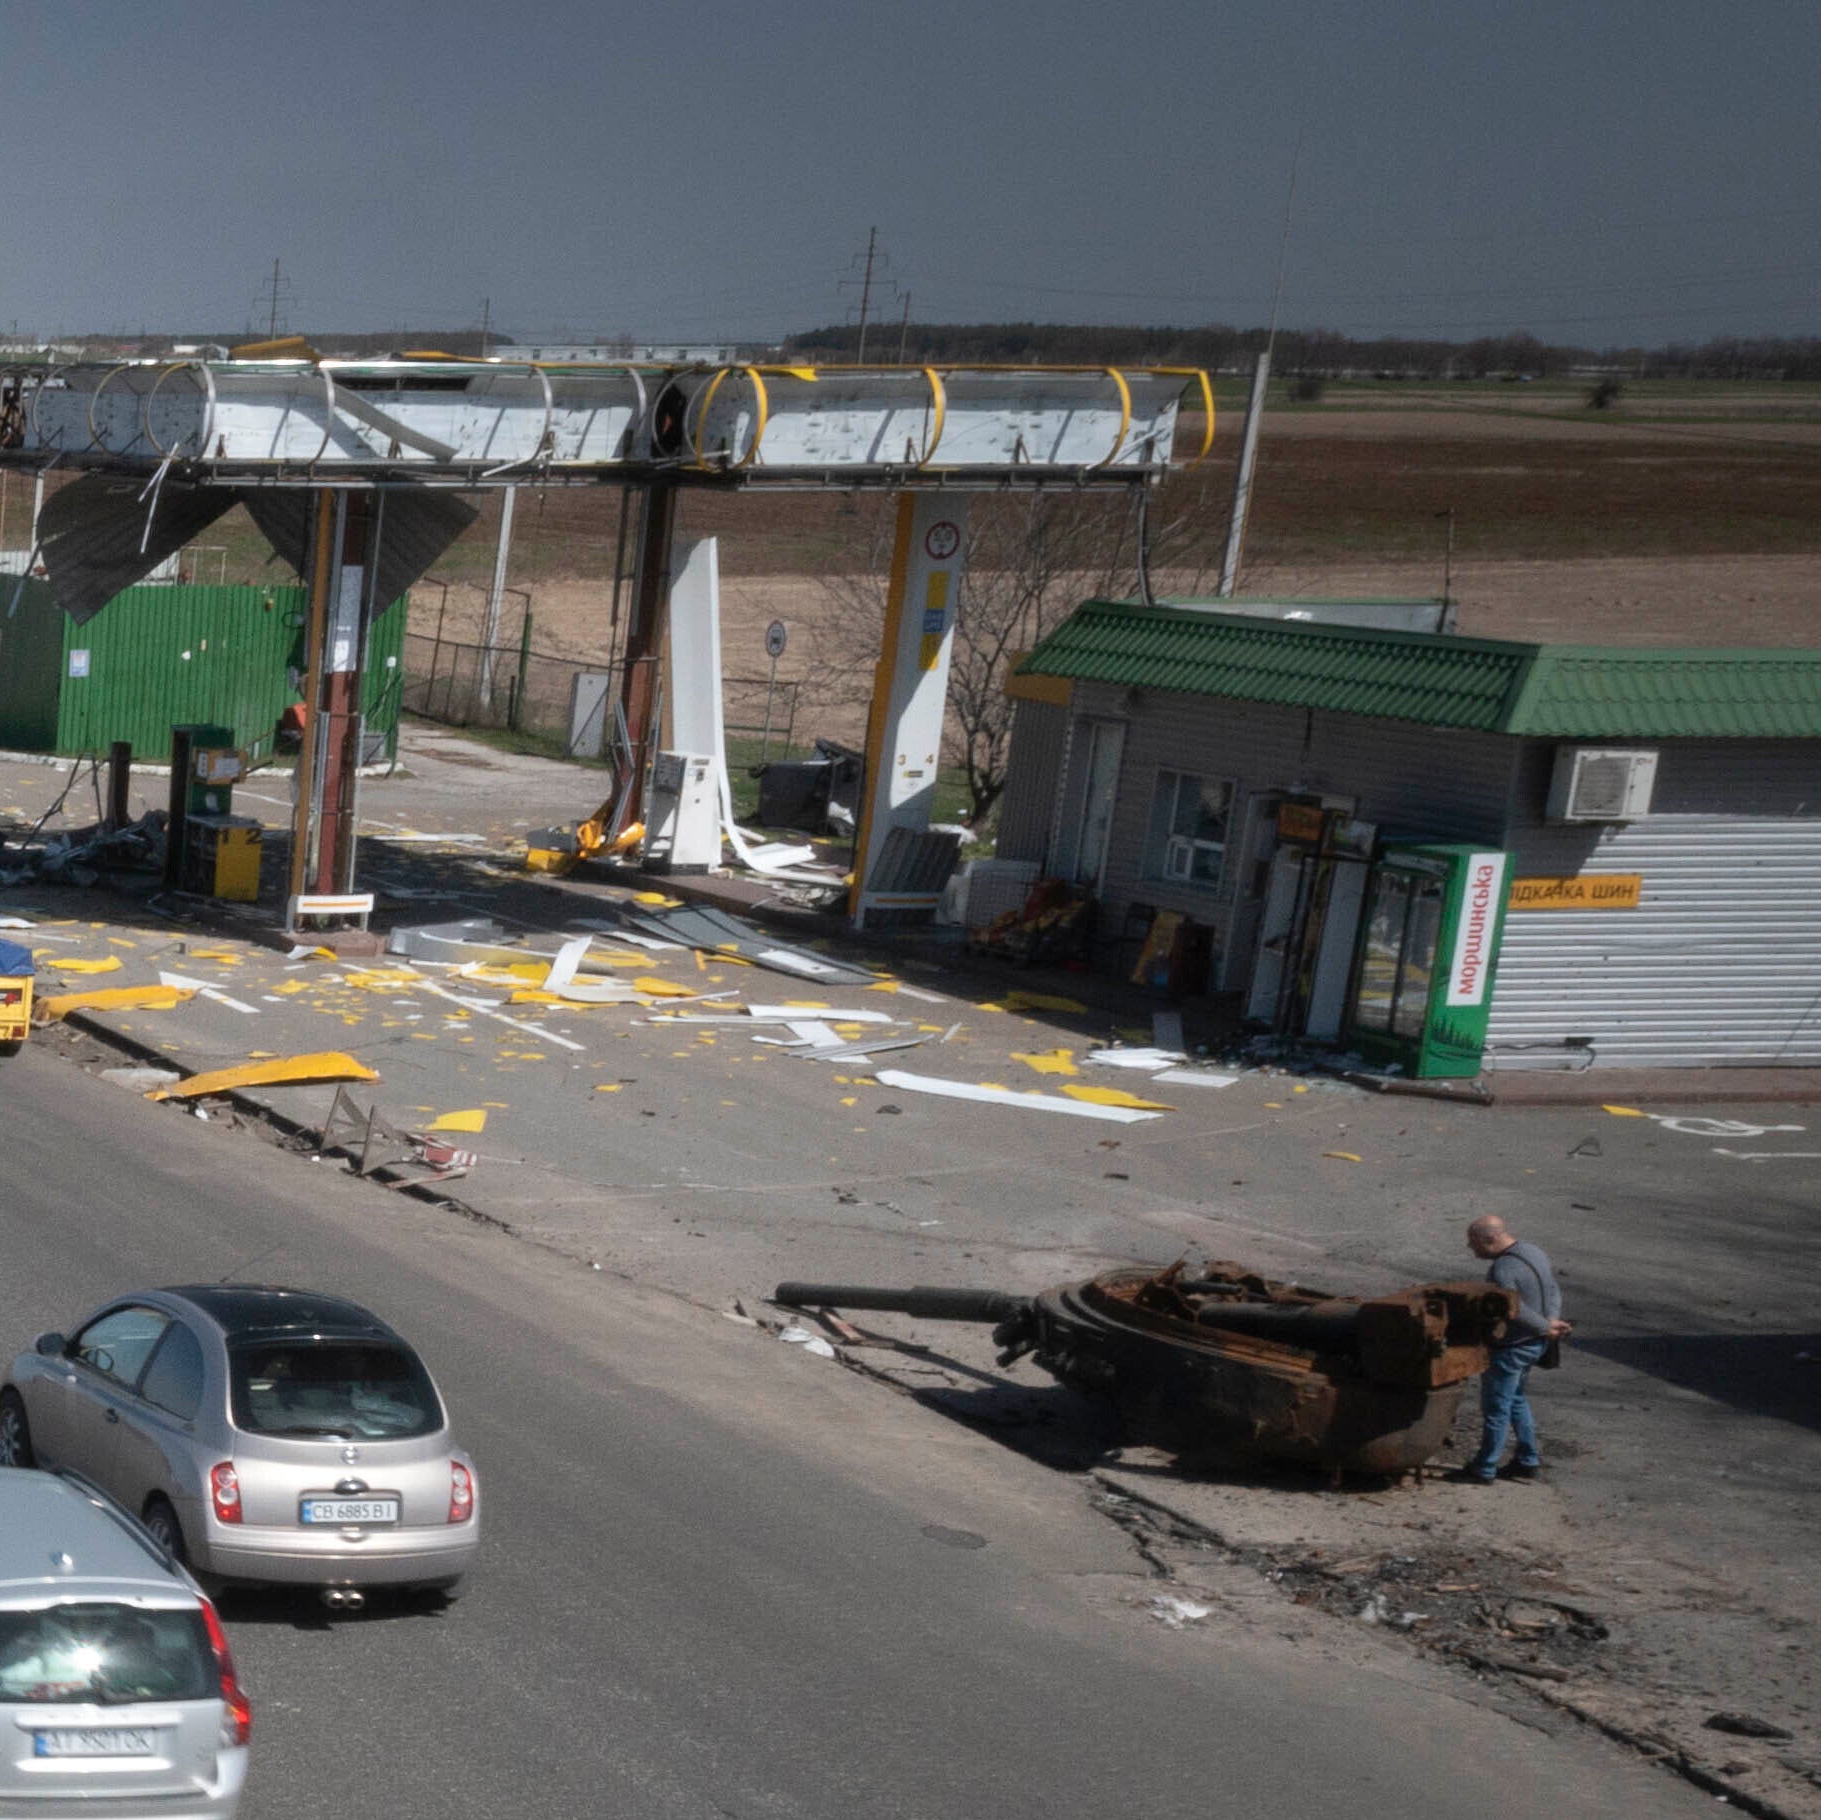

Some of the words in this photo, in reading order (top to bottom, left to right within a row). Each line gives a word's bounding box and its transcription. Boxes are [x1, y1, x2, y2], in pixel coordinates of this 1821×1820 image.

[898, 754, 906, 766] 3
[925, 753, 934, 765] 4
[1590, 884, 1634, 900] ШИН
[1458, 865, 1494, 995] моршинська
[312, 1504, 333, 1518] CB
[337, 1504, 370, 1518] 6885
[373, 1504, 391, 1517] BI
